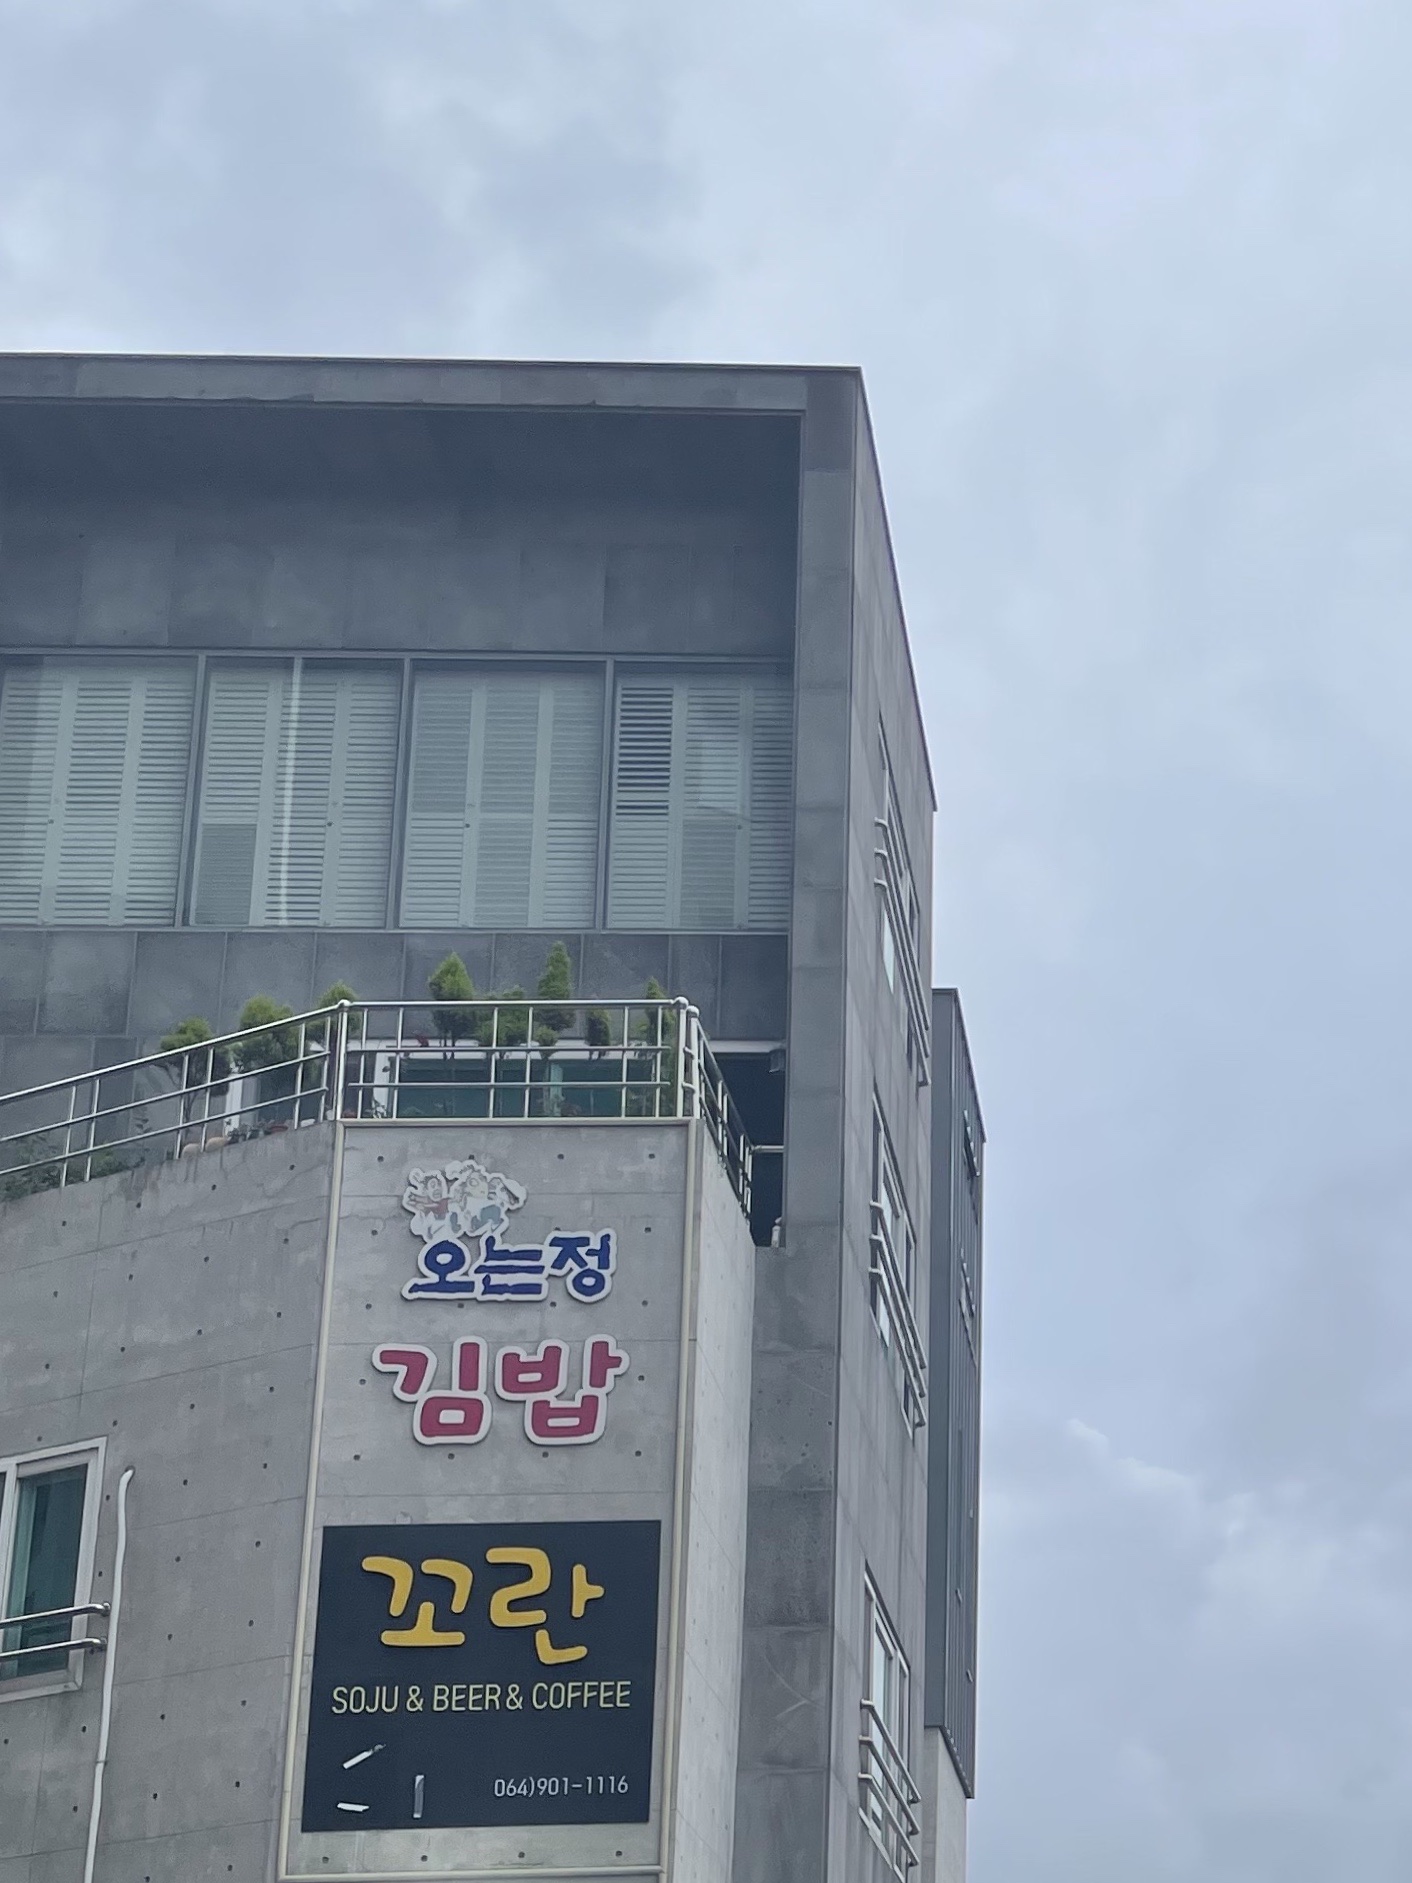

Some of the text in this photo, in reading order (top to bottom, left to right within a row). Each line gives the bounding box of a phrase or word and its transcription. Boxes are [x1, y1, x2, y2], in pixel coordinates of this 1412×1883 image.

[407, 1231, 613, 1299] 오는정
[378, 1340, 624, 1441] 김밥
[361, 1546, 605, 1665] 꼬란
[331, 1680, 632, 1714] SOJU & BEER & COFFEE
[493, 1775, 629, 1798] 064)901-1116
